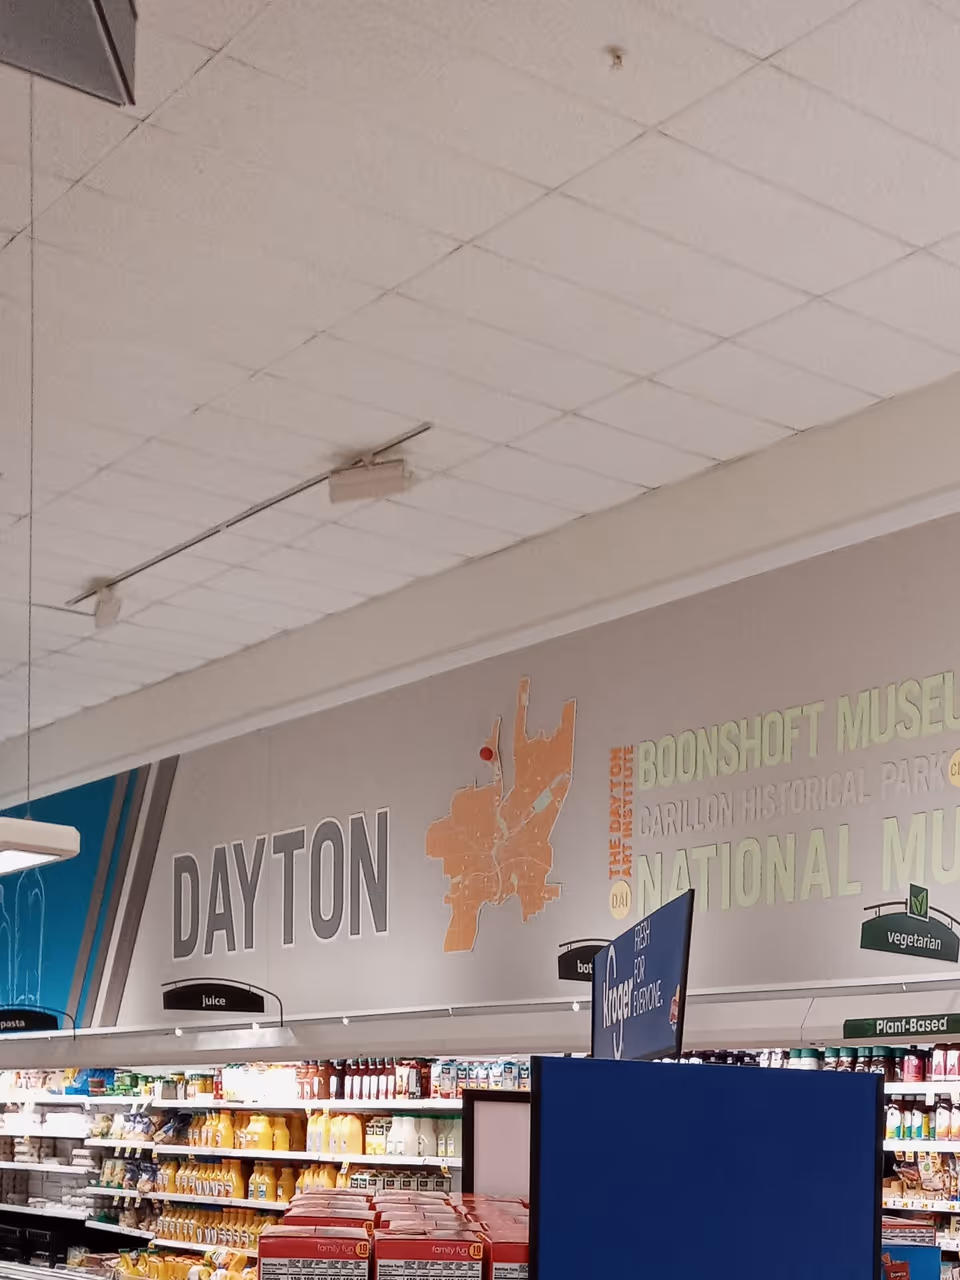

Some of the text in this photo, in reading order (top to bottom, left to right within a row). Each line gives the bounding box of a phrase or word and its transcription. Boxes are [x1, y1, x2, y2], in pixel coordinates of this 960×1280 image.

[637, 702, 825, 791] BOONSHOFT
[638, 750, 948, 839] CARILLON HISTORICAL PARK
[609, 748, 622, 880] THE DAYTON
[622, 745, 633, 877] ART INSTITUTE
[171, 807, 390, 961] DAYTON
[636, 823, 863, 918] NATIONAL
[611, 890, 628, 908] DAI
[634, 918, 650, 952] FRESH
[887, 930, 942, 951] vegetarian
[577, 960, 593, 974] bot
[633, 955, 646, 984] FOR
[201, 995, 226, 1007] juice
[602, 944, 634, 1061] Kroger
[876, 1016, 948, 1035] Plant-Based
[317, 1243, 354, 1255] family fun
[432, 1245, 468, 1257] family fun
